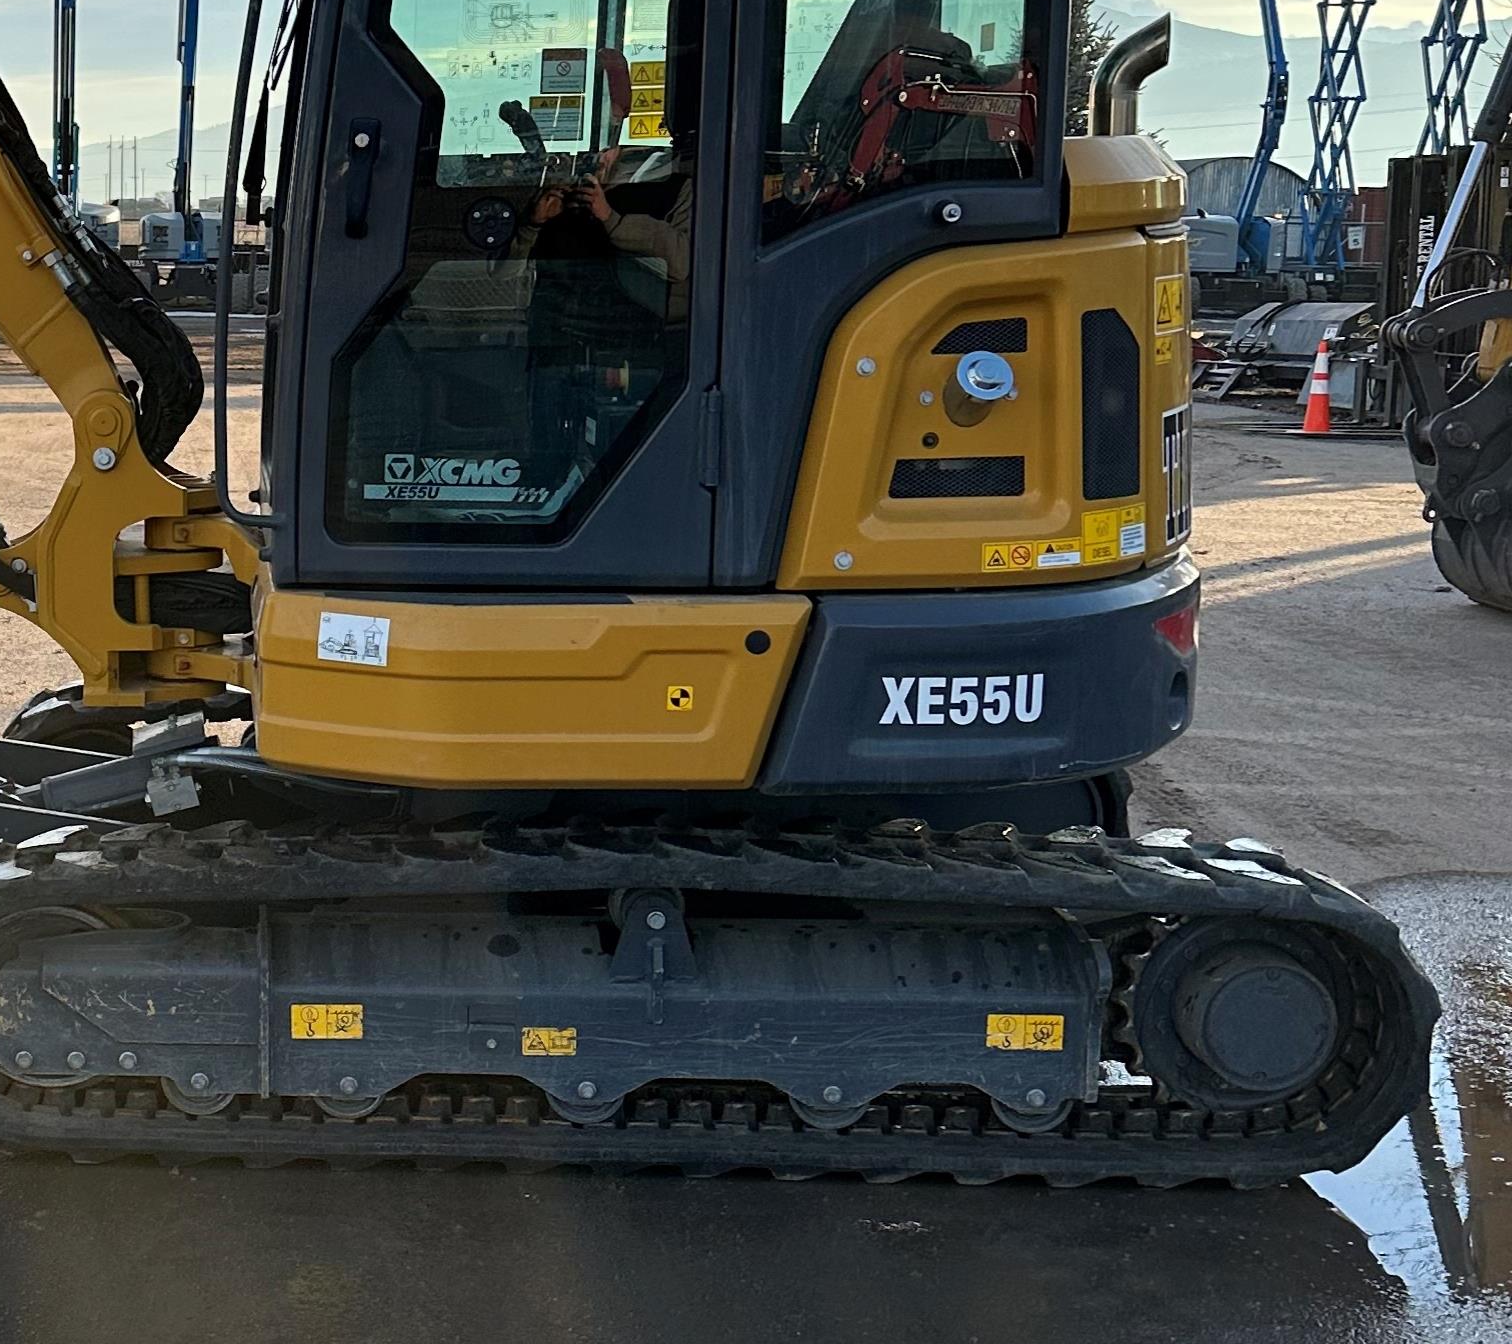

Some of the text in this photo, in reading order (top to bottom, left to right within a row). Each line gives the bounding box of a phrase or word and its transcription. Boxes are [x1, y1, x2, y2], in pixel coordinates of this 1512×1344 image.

[1416, 215, 1435, 264] RENTAL
[414, 457, 522, 485] XCMG
[385, 485, 440, 499] XE55U
[878, 673, 1045, 726] XE55U
